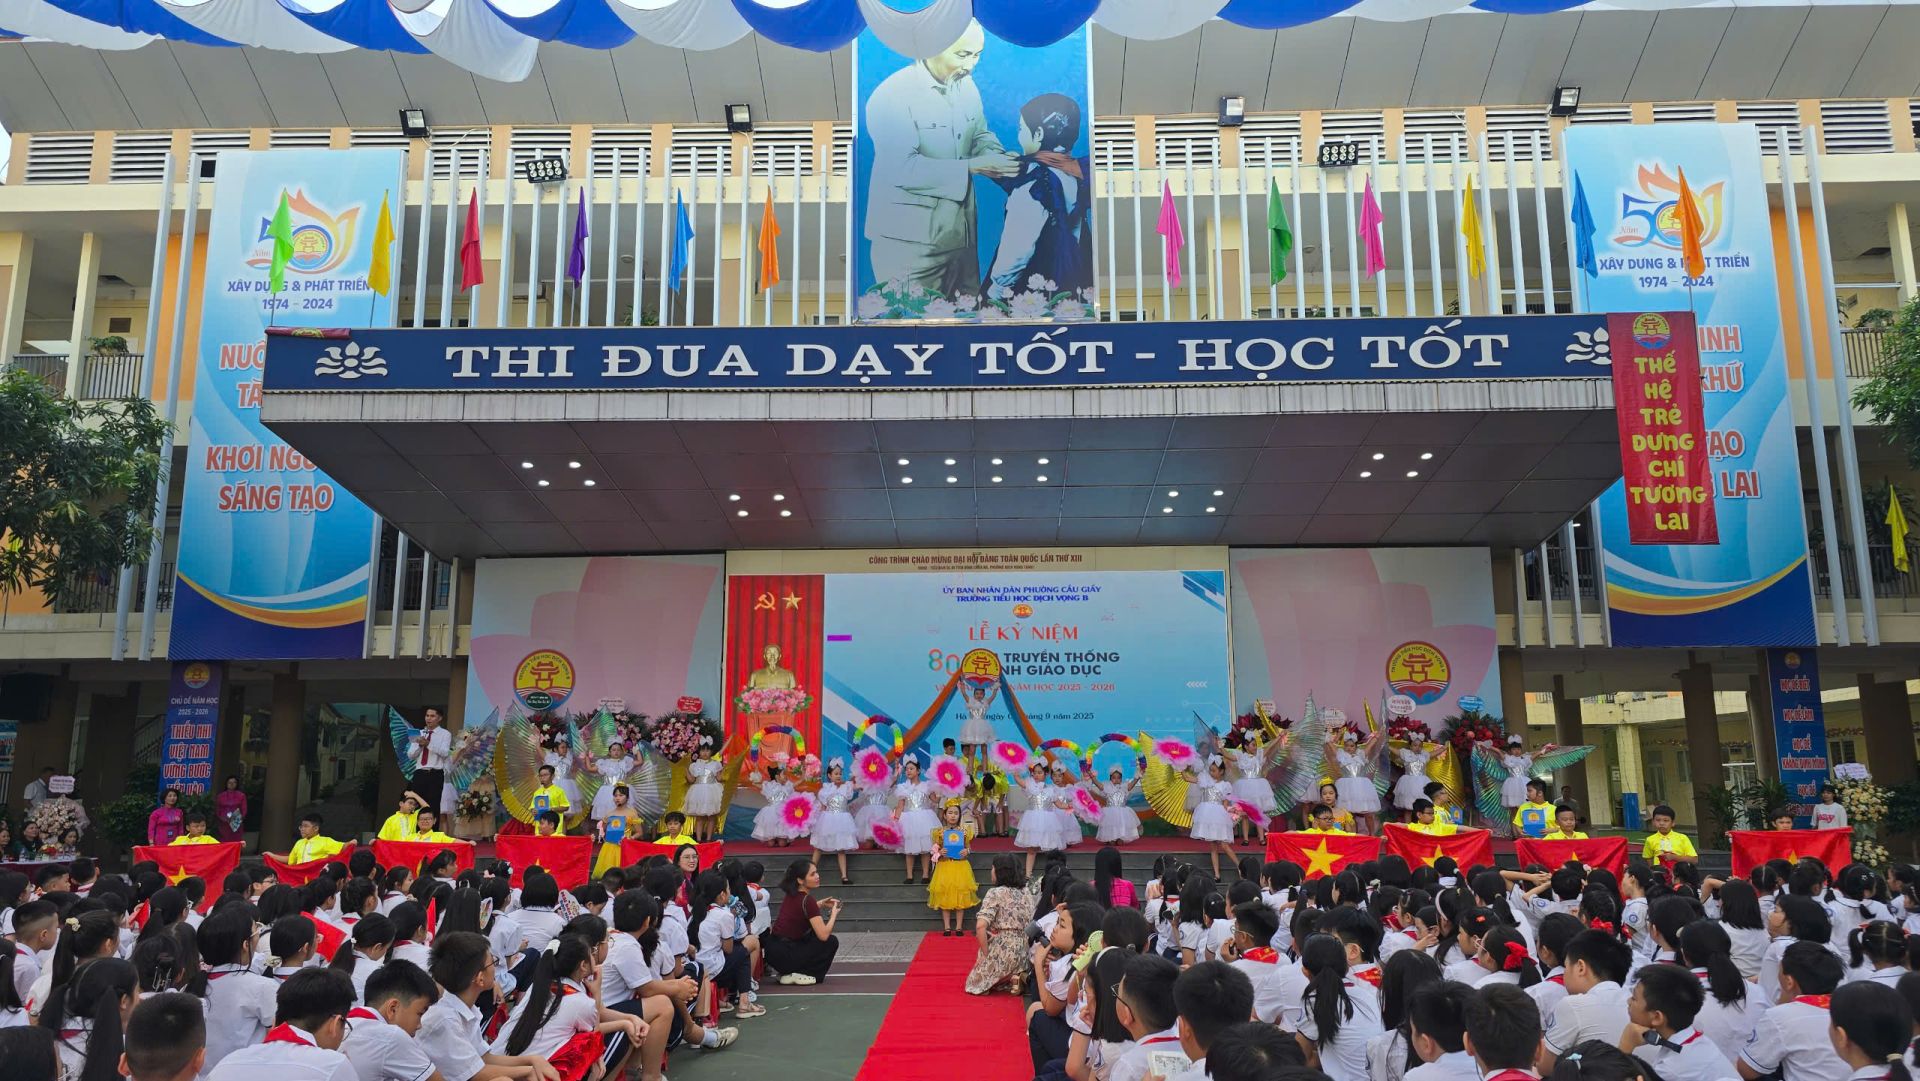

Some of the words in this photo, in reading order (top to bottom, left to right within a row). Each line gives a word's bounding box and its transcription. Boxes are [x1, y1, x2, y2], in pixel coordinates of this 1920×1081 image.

[1600, 256, 1624, 270] XÂY
[1667, 257, 1676, 269] &
[1715, 252, 1750, 268] TRIỂN
[228, 279, 252, 292] XÂY
[292, 280, 301, 292] &
[304, 279, 335, 292] PHÁT
[1638, 276, 1668, 288] 1974
[1682, 276, 1714, 287] 2024
[262, 298, 289, 310] 1974
[302, 298, 334, 309] 2024
[1699, 326, 1740, 350] INH
[445, 345, 575, 378] THI
[600, 344, 759, 377] ĐUA
[786, 344, 944, 384] DẠY
[970, 326, 1113, 375] TỐT
[1178, 336, 1334, 380] HỌC
[1360, 318, 1509, 369] TỐT
[1706, 430, 1744, 461] ẠO
[206, 443, 264, 471] KHƠI
[1648, 455, 1686, 478] CHÍ
[1721, 472, 1759, 497] LAI
[218, 480, 282, 510] SÁNG
[288, 484, 334, 514] TẠO
[869, 555, 888, 564] CÔNG
[890, 554, 910, 564] TRÌNH
[912, 555, 930, 564] CHÀO
[1000, 554, 1018, 563] TOÀN
[1020, 553, 1038, 563] QUỐC
[1056, 554, 1068, 562] THỨ
[1070, 554, 1082, 562] XIII
[943, 586, 955, 594] ỦY
[976, 586, 1000, 594] NHÂN
[1003, 586, 1020, 594] DÂN
[1023, 585, 1059, 593] PHƯỜNG
[1061, 584, 1079, 592] CẦU
[1081, 584, 1102, 592] GIẤY
[957, 594, 990, 602] TRƯỜNG
[993, 592, 1010, 602] TIỂU
[969, 621, 990, 640] LỄ
[998, 622, 1023, 640] KỶ
[1032, 623, 1078, 644] NIỆM
[928, 648, 960, 676] 80
[1004, 649, 1060, 662] TRUYỀN
[1064, 648, 1120, 662] THỐNG
[1026, 663, 1066, 676] GIÁO
[1070, 665, 1102, 678] DỤC
[170, 720, 196, 739] THIẾU
[169, 742, 188, 762] VIỆT
[188, 744, 210, 758] NAM
